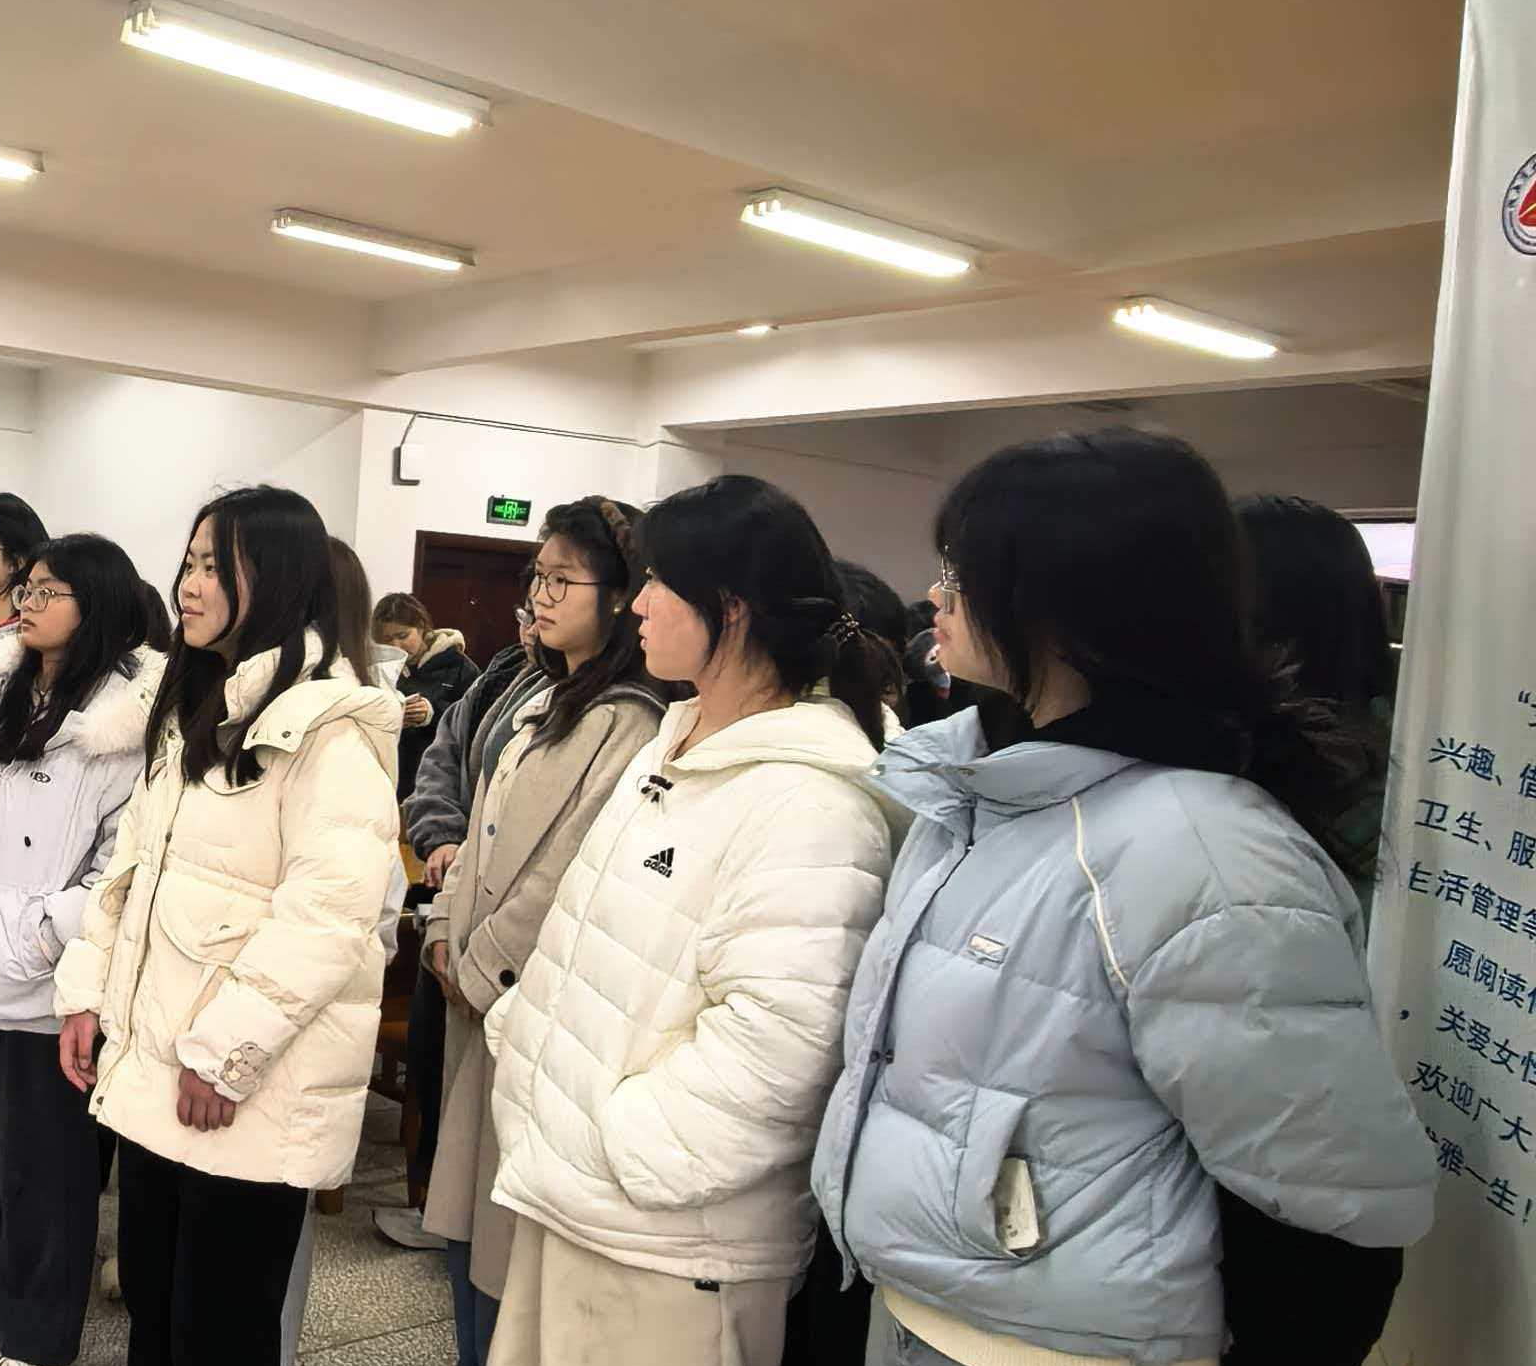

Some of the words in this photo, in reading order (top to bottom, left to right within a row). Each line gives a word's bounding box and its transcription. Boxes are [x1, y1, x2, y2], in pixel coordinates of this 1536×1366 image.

[643, 859, 672, 878] adidas
[1414, 798, 1536, 869] 卫生、服
[1443, 939, 1536, 1014] 愿阅读
[1425, 1126, 1533, 1224] 雅一生！
